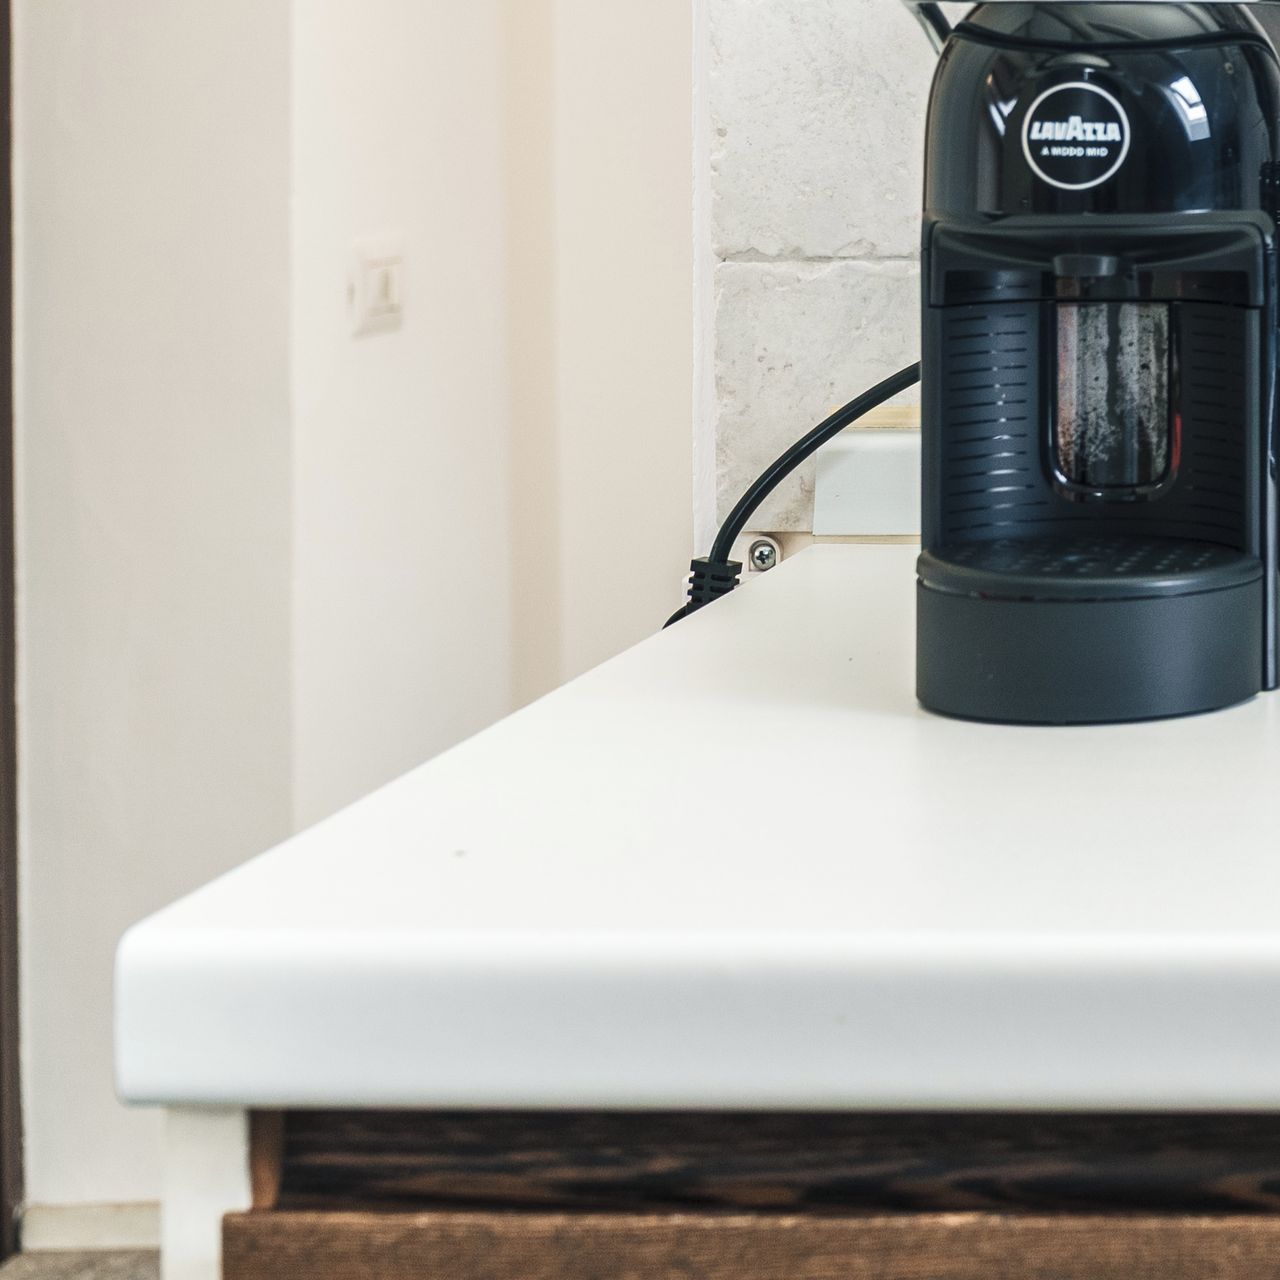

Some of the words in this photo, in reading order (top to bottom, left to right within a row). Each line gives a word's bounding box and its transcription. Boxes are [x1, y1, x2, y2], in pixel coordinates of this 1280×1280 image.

[1029, 115, 1121, 141] LAVAZZA
[1040, 146, 1050, 156] A
[1050, 146, 1084, 157] MODO
[1085, 146, 1109, 157] MIO
